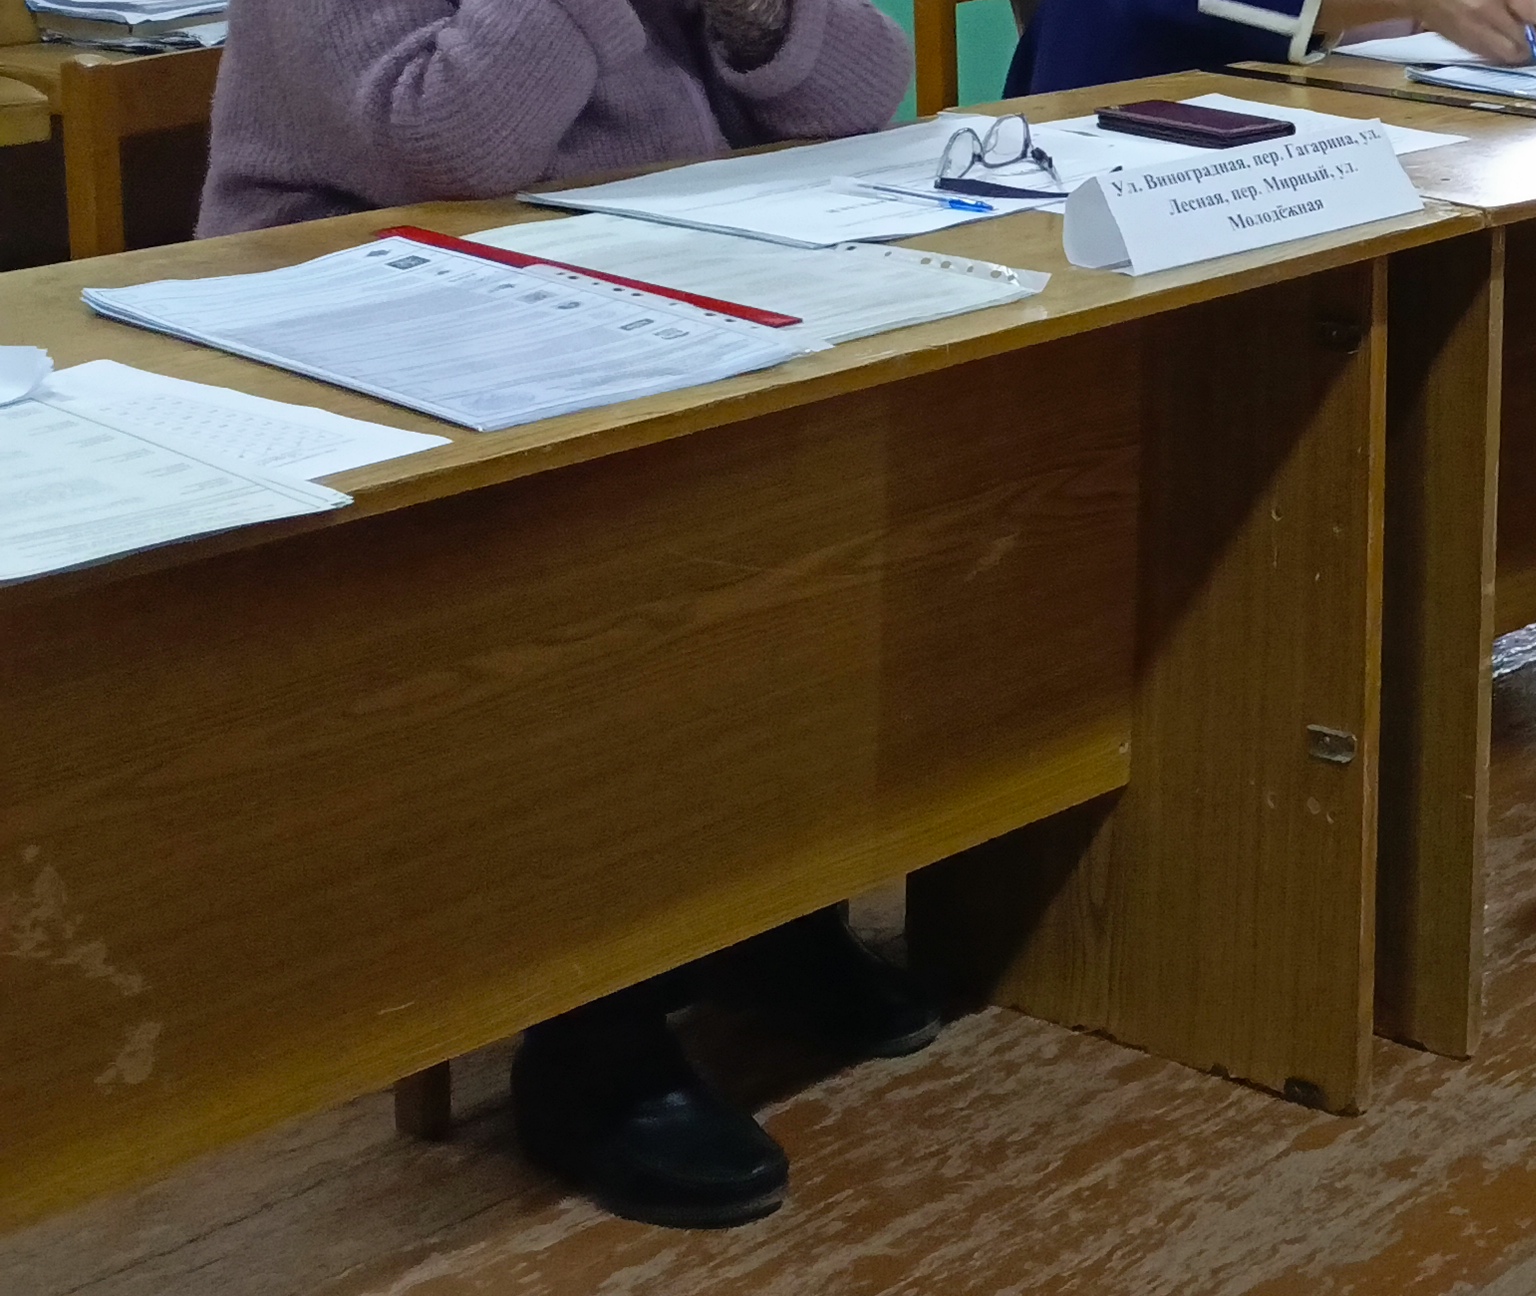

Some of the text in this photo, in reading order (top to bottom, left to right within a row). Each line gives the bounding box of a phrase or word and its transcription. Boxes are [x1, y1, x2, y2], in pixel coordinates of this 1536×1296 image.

[1112, 180, 1143, 196] Ул.
[1253, 151, 1283, 166] пер.
[1285, 132, 1359, 159] Гагарина,
[1359, 128, 1382, 146] ул.
[1168, 160, 1359, 215] Лесная, пер. Мирный, ул.
[1227, 197, 1325, 231] Молодёжная
